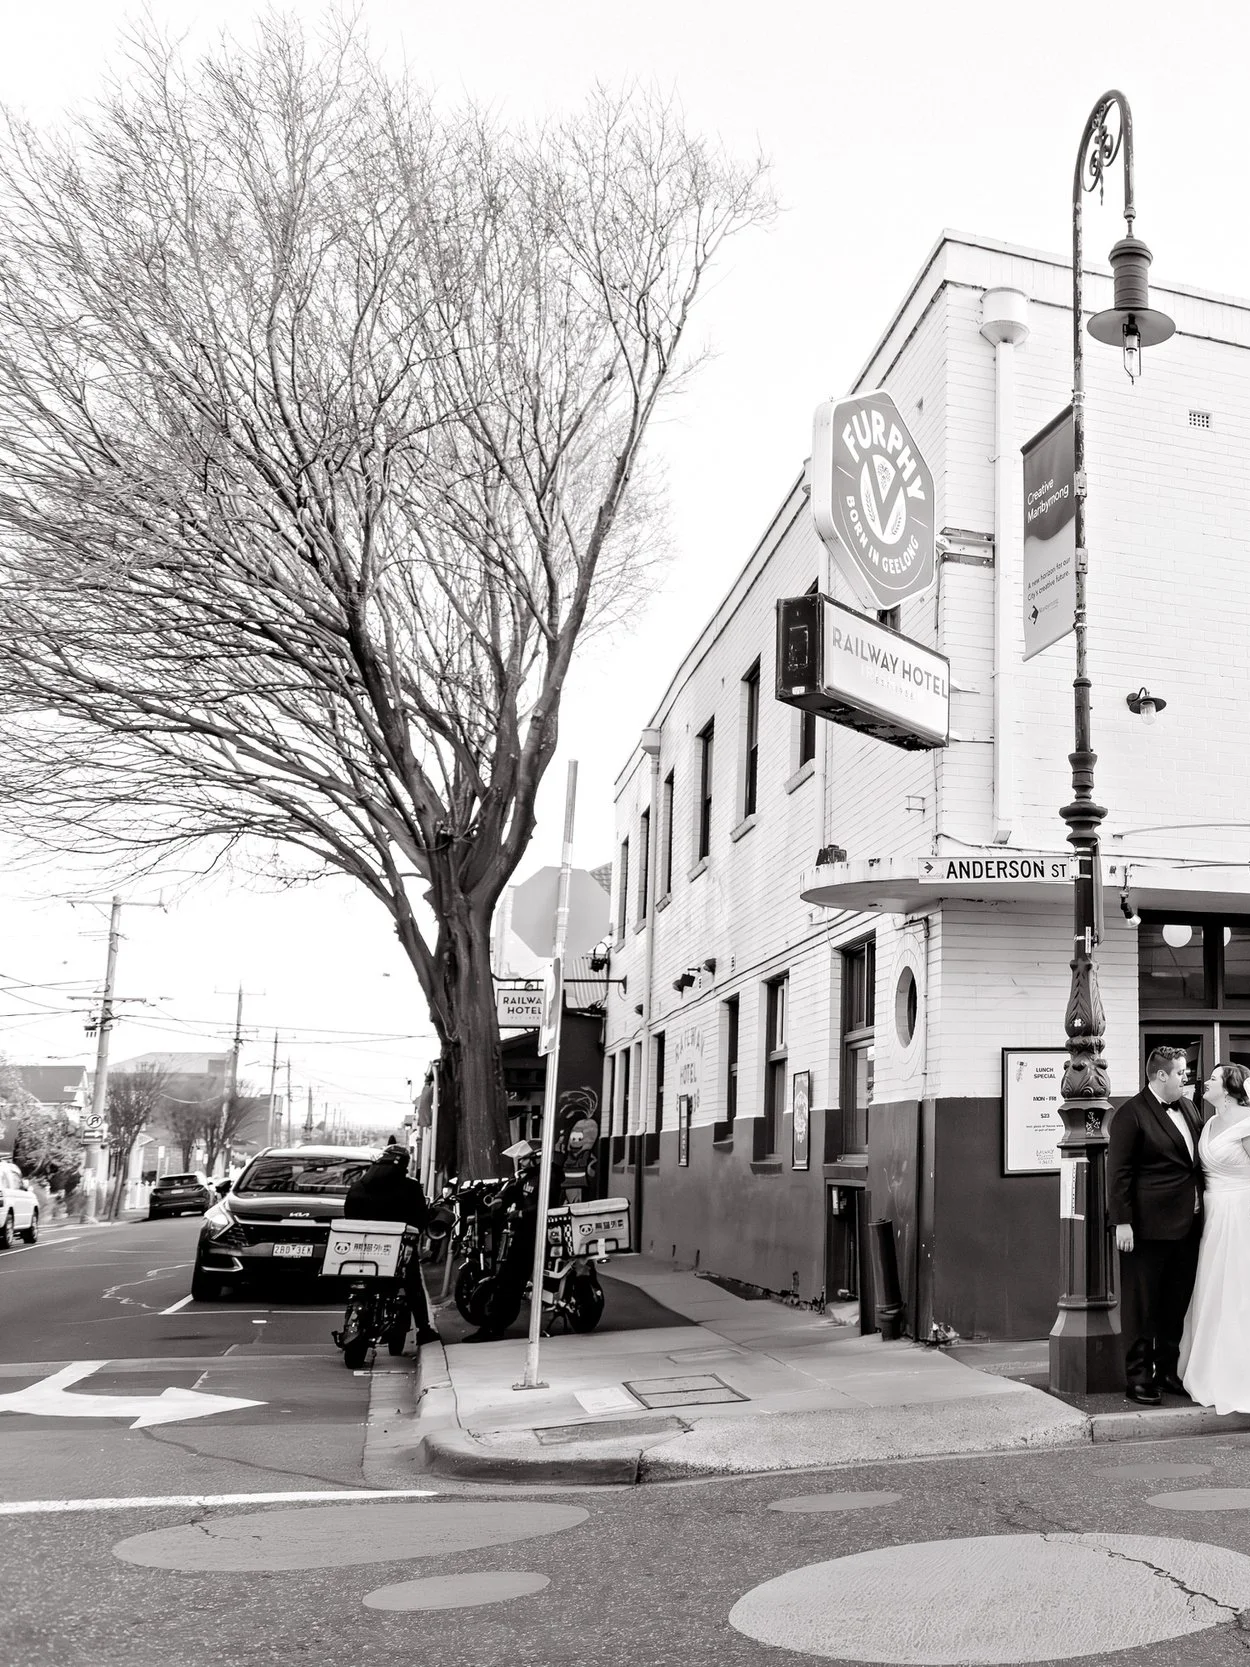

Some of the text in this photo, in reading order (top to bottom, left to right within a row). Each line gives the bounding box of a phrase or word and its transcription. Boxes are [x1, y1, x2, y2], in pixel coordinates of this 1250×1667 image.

[842, 409, 926, 501] FURPHY
[1027, 478, 1054, 506] Creative
[846, 495, 919, 574] BORN IN GEELONG
[832, 625, 948, 699] RAILWAY HOTEL
[946, 860, 1067, 879] ANDERSON ST
[503, 996, 543, 1005] RAILWA
[507, 1006, 542, 1014] HOTEL
